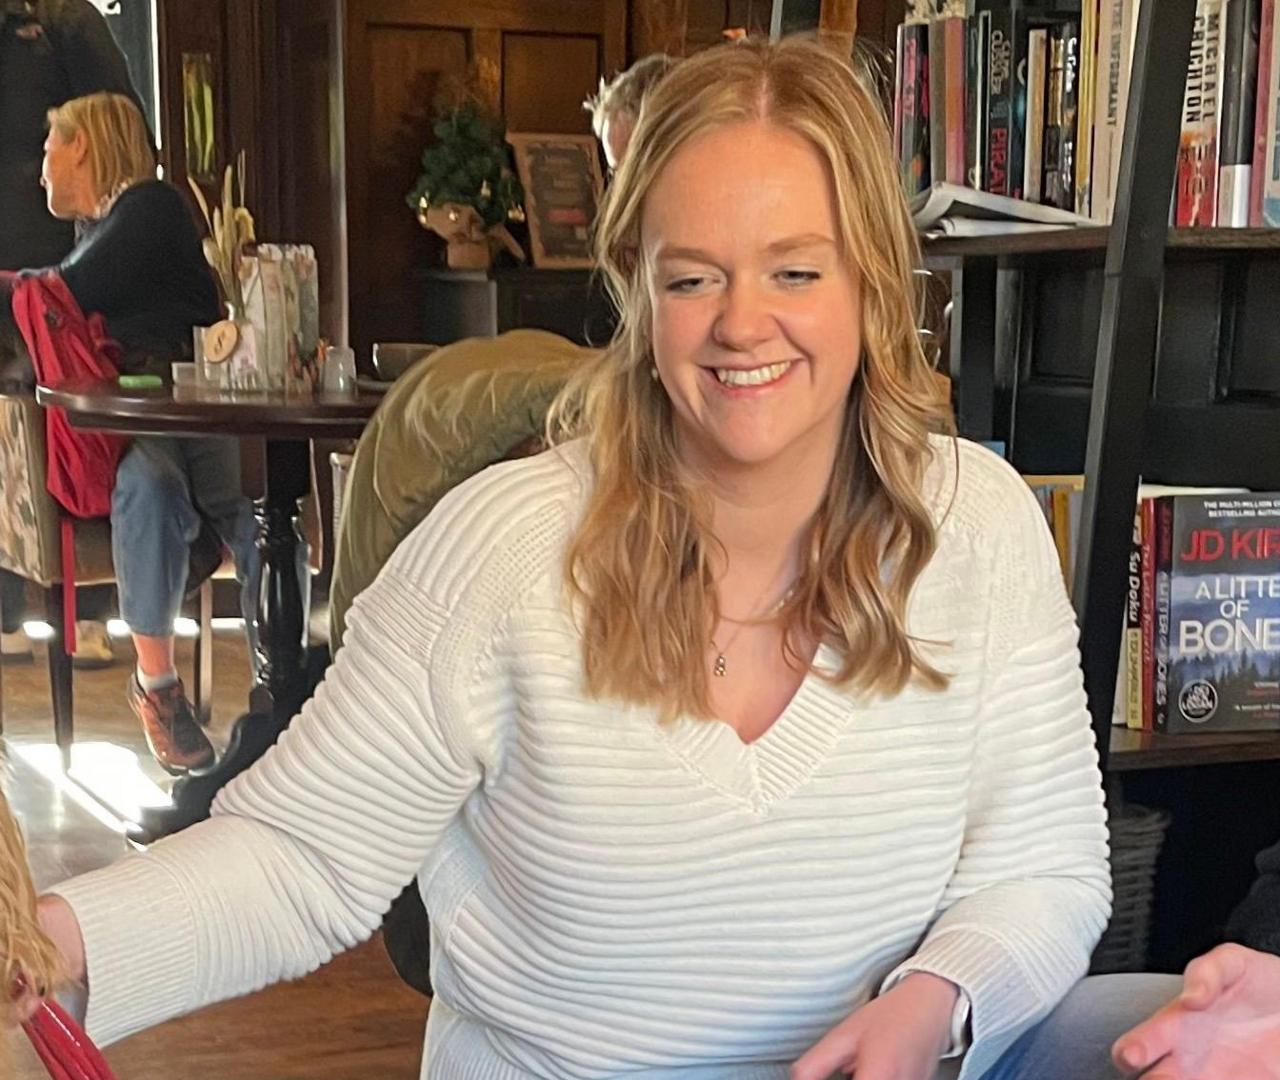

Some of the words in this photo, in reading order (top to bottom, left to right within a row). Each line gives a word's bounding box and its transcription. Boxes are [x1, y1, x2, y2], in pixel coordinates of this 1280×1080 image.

[990, 29, 1003, 95] CUSSLER
[1185, 16, 1206, 124] CRICHTON
[1202, 13, 1220, 122] MICHAEL
[989, 127, 1008, 195] PIRAT
[1129, 551, 1141, 570] Su
[1181, 527, 1225, 562] JD
[1128, 575, 1141, 622] Doku
[1194, 581, 1211, 599] A
[1220, 599, 1250, 618] OF
